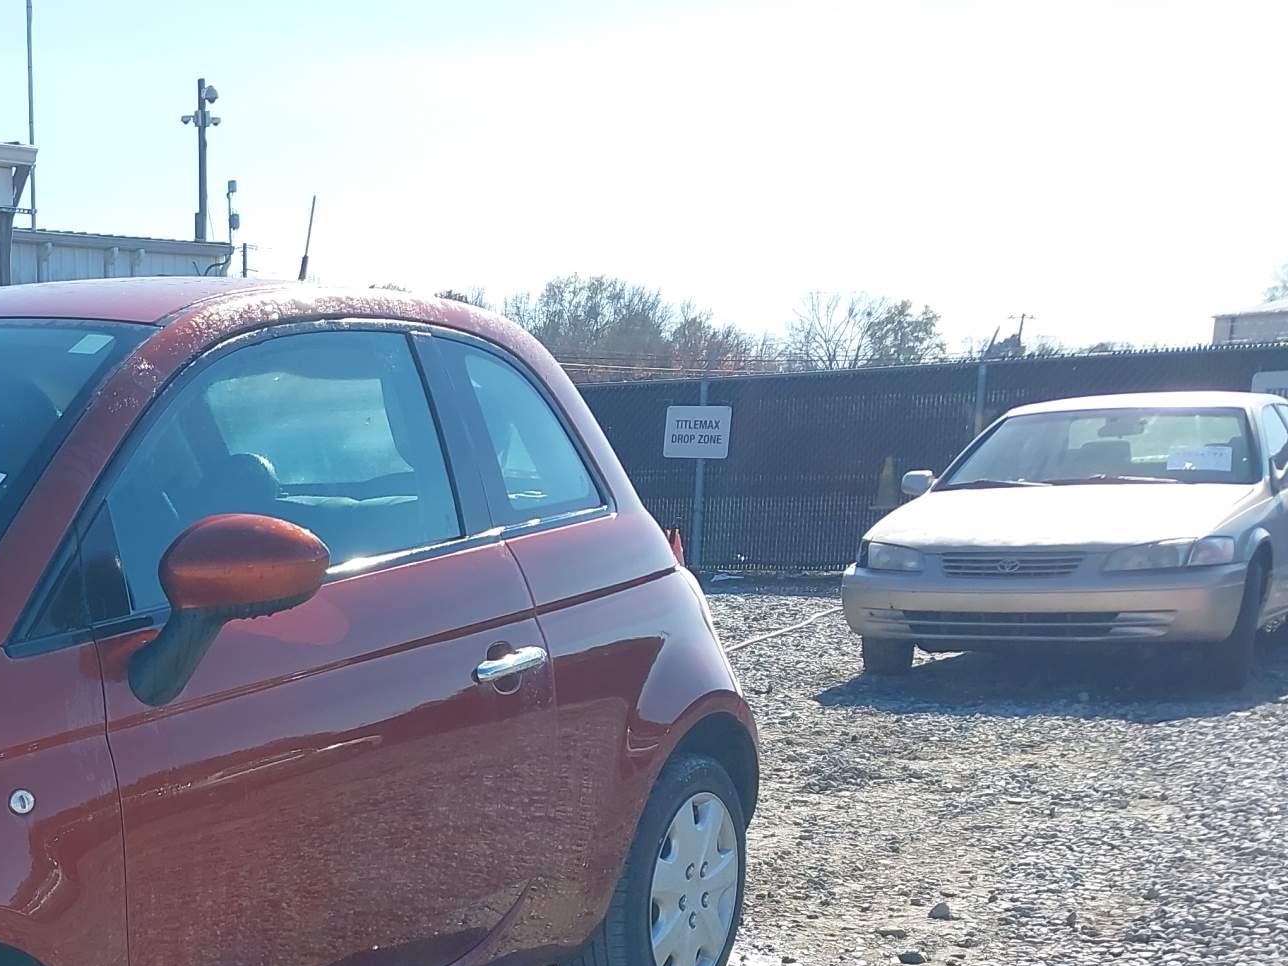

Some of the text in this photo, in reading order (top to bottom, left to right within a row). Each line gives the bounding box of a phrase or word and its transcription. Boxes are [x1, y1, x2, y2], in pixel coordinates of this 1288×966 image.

[676, 420, 720, 430] TITLEMAX
[672, 434, 722, 444] DROP ZONE
